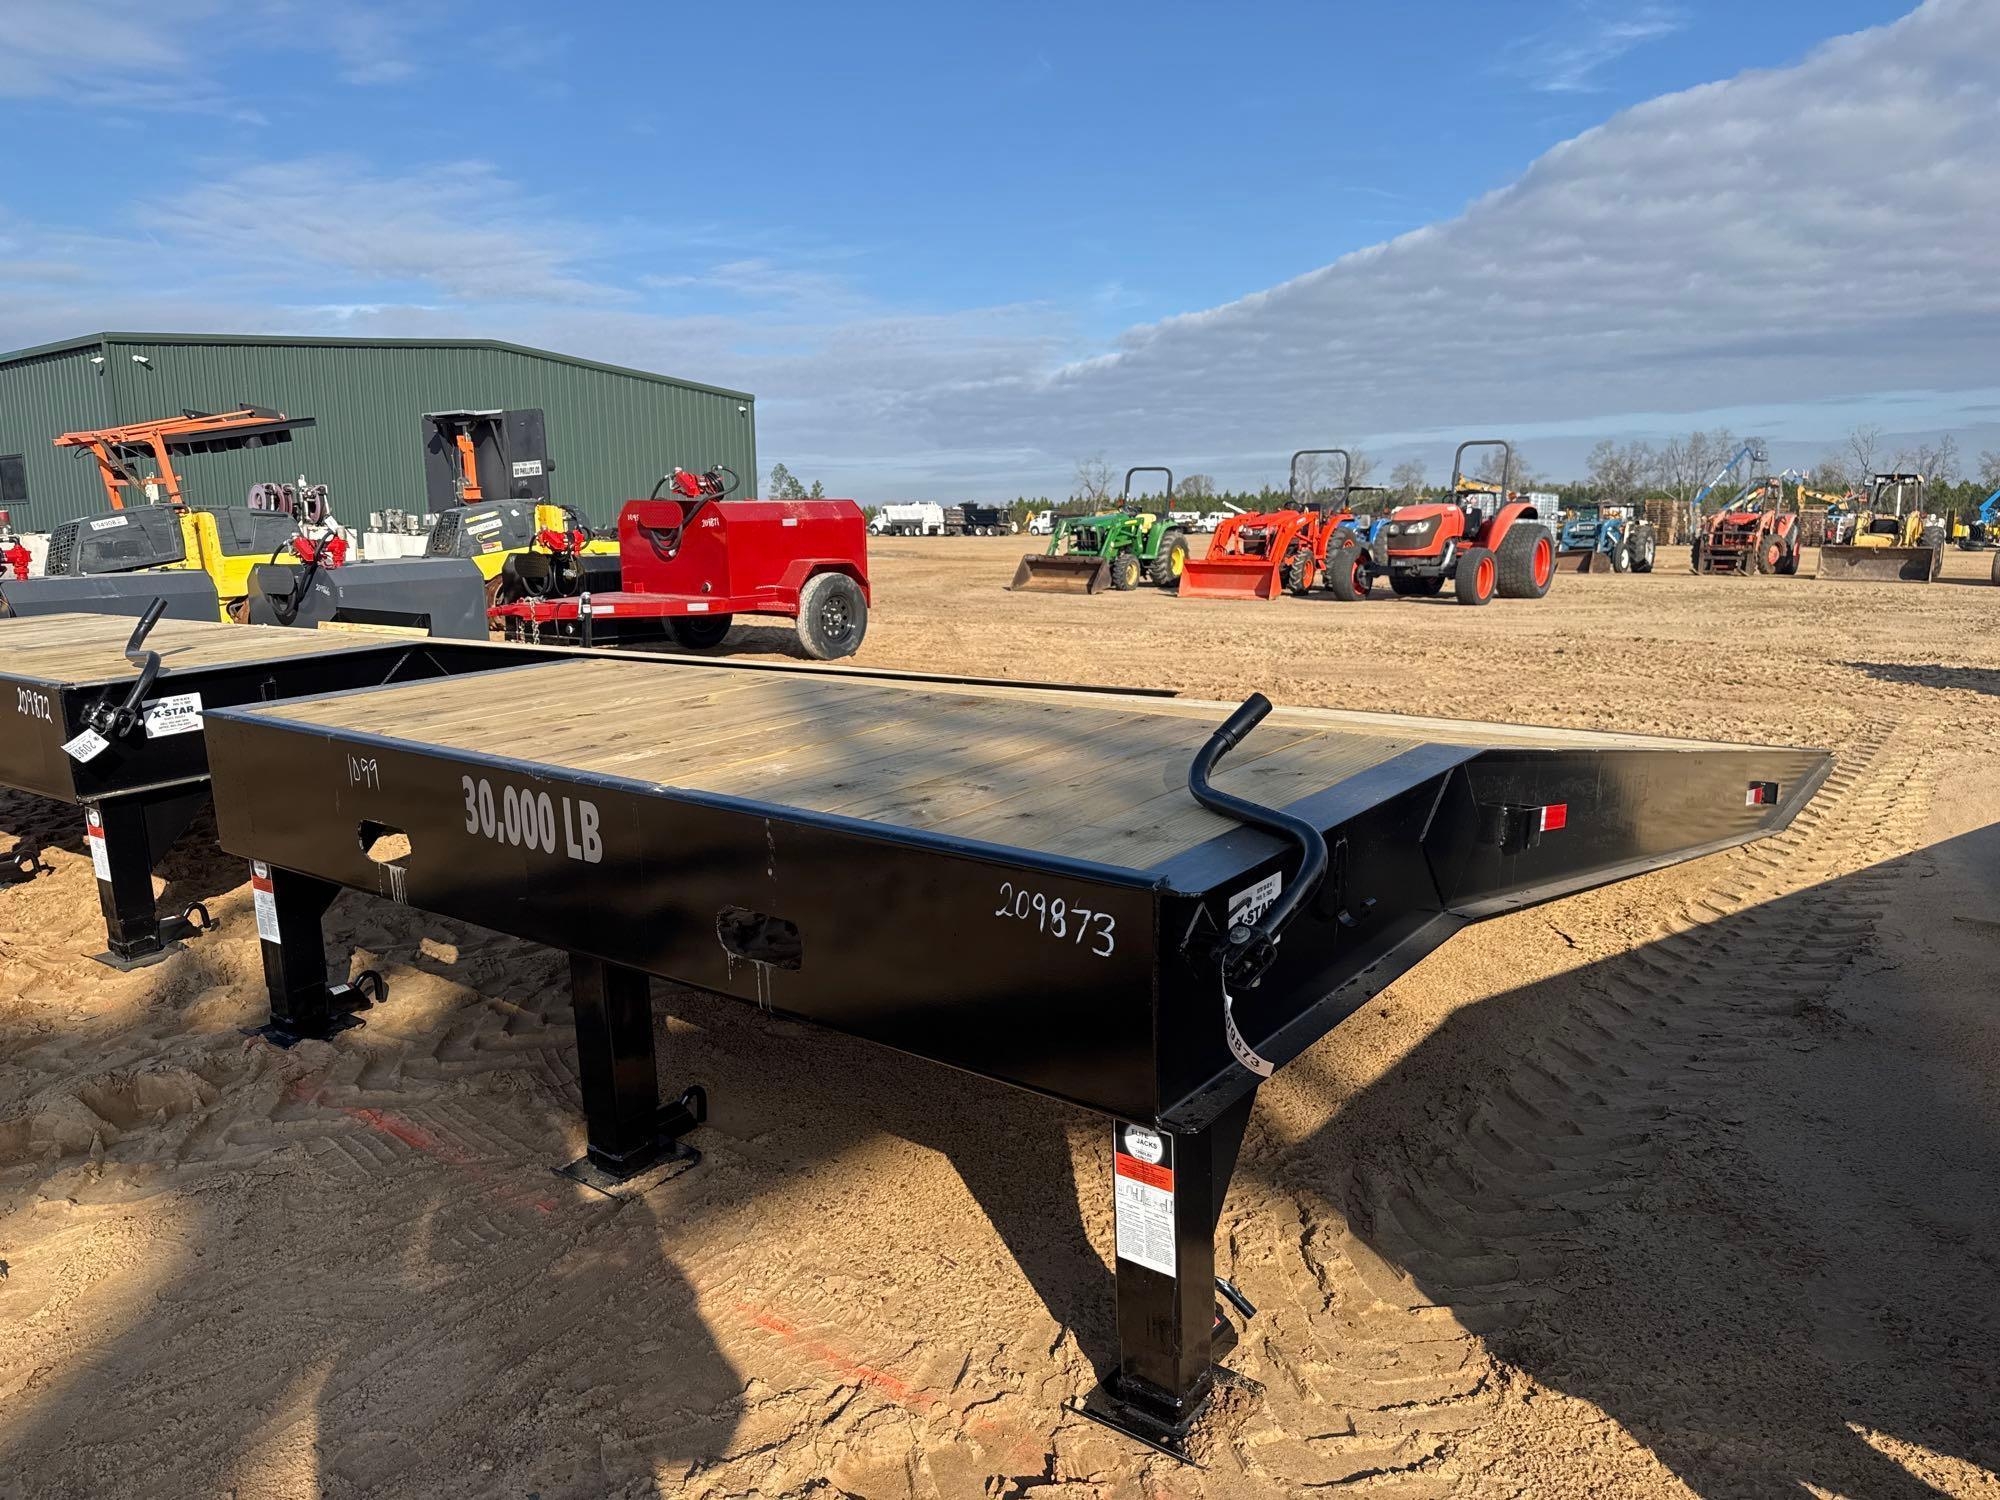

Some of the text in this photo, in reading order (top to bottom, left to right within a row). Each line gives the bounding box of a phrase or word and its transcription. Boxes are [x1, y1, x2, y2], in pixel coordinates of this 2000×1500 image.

[17, 686, 53, 724] 209872
[153, 705, 195, 719] X-STAR
[347, 753, 381, 791] 1099
[562, 796, 603, 864] LB
[995, 881, 1116, 958] 209873
[1136, 1138, 1158, 1150] JACKS
